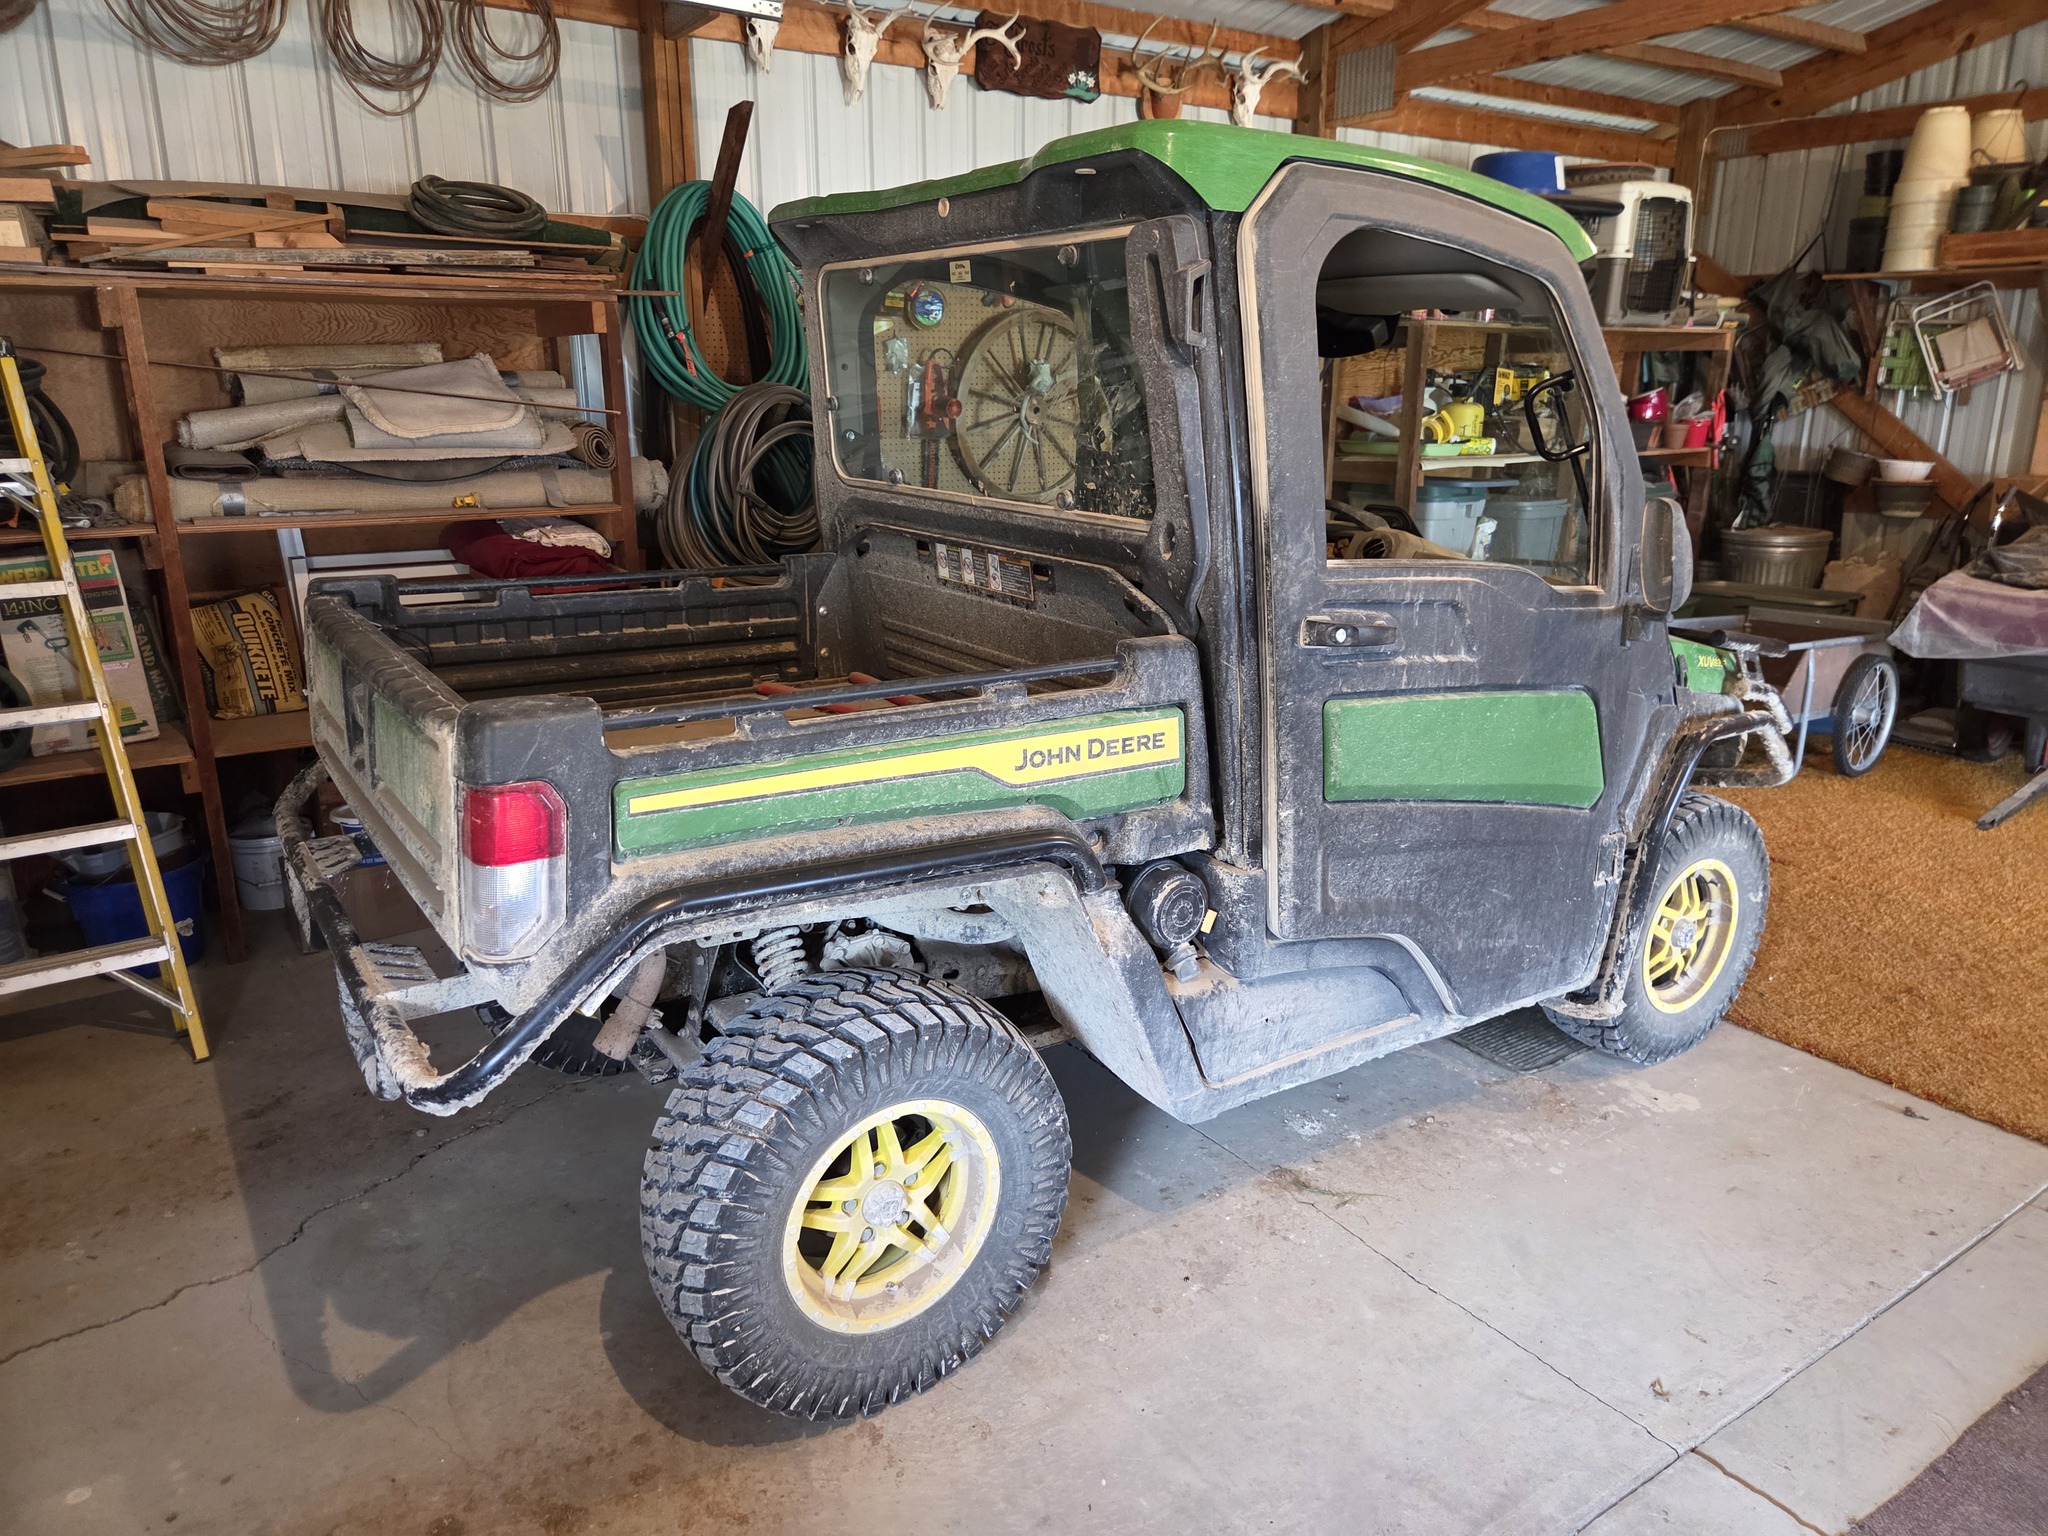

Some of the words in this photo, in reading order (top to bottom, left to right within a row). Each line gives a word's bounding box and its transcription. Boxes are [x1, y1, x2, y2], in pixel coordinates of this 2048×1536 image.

[75, 560, 112, 577] TER
[134, 623, 156, 667] SAND
[149, 669, 172, 700] MIX
[231, 611, 279, 701] QUIKRETE
[262, 609, 289, 667] CONCRETE
[283, 669, 297, 693] MIX
[1014, 745, 1081, 771] JOHN
[1087, 732, 1166, 760] DEERE
